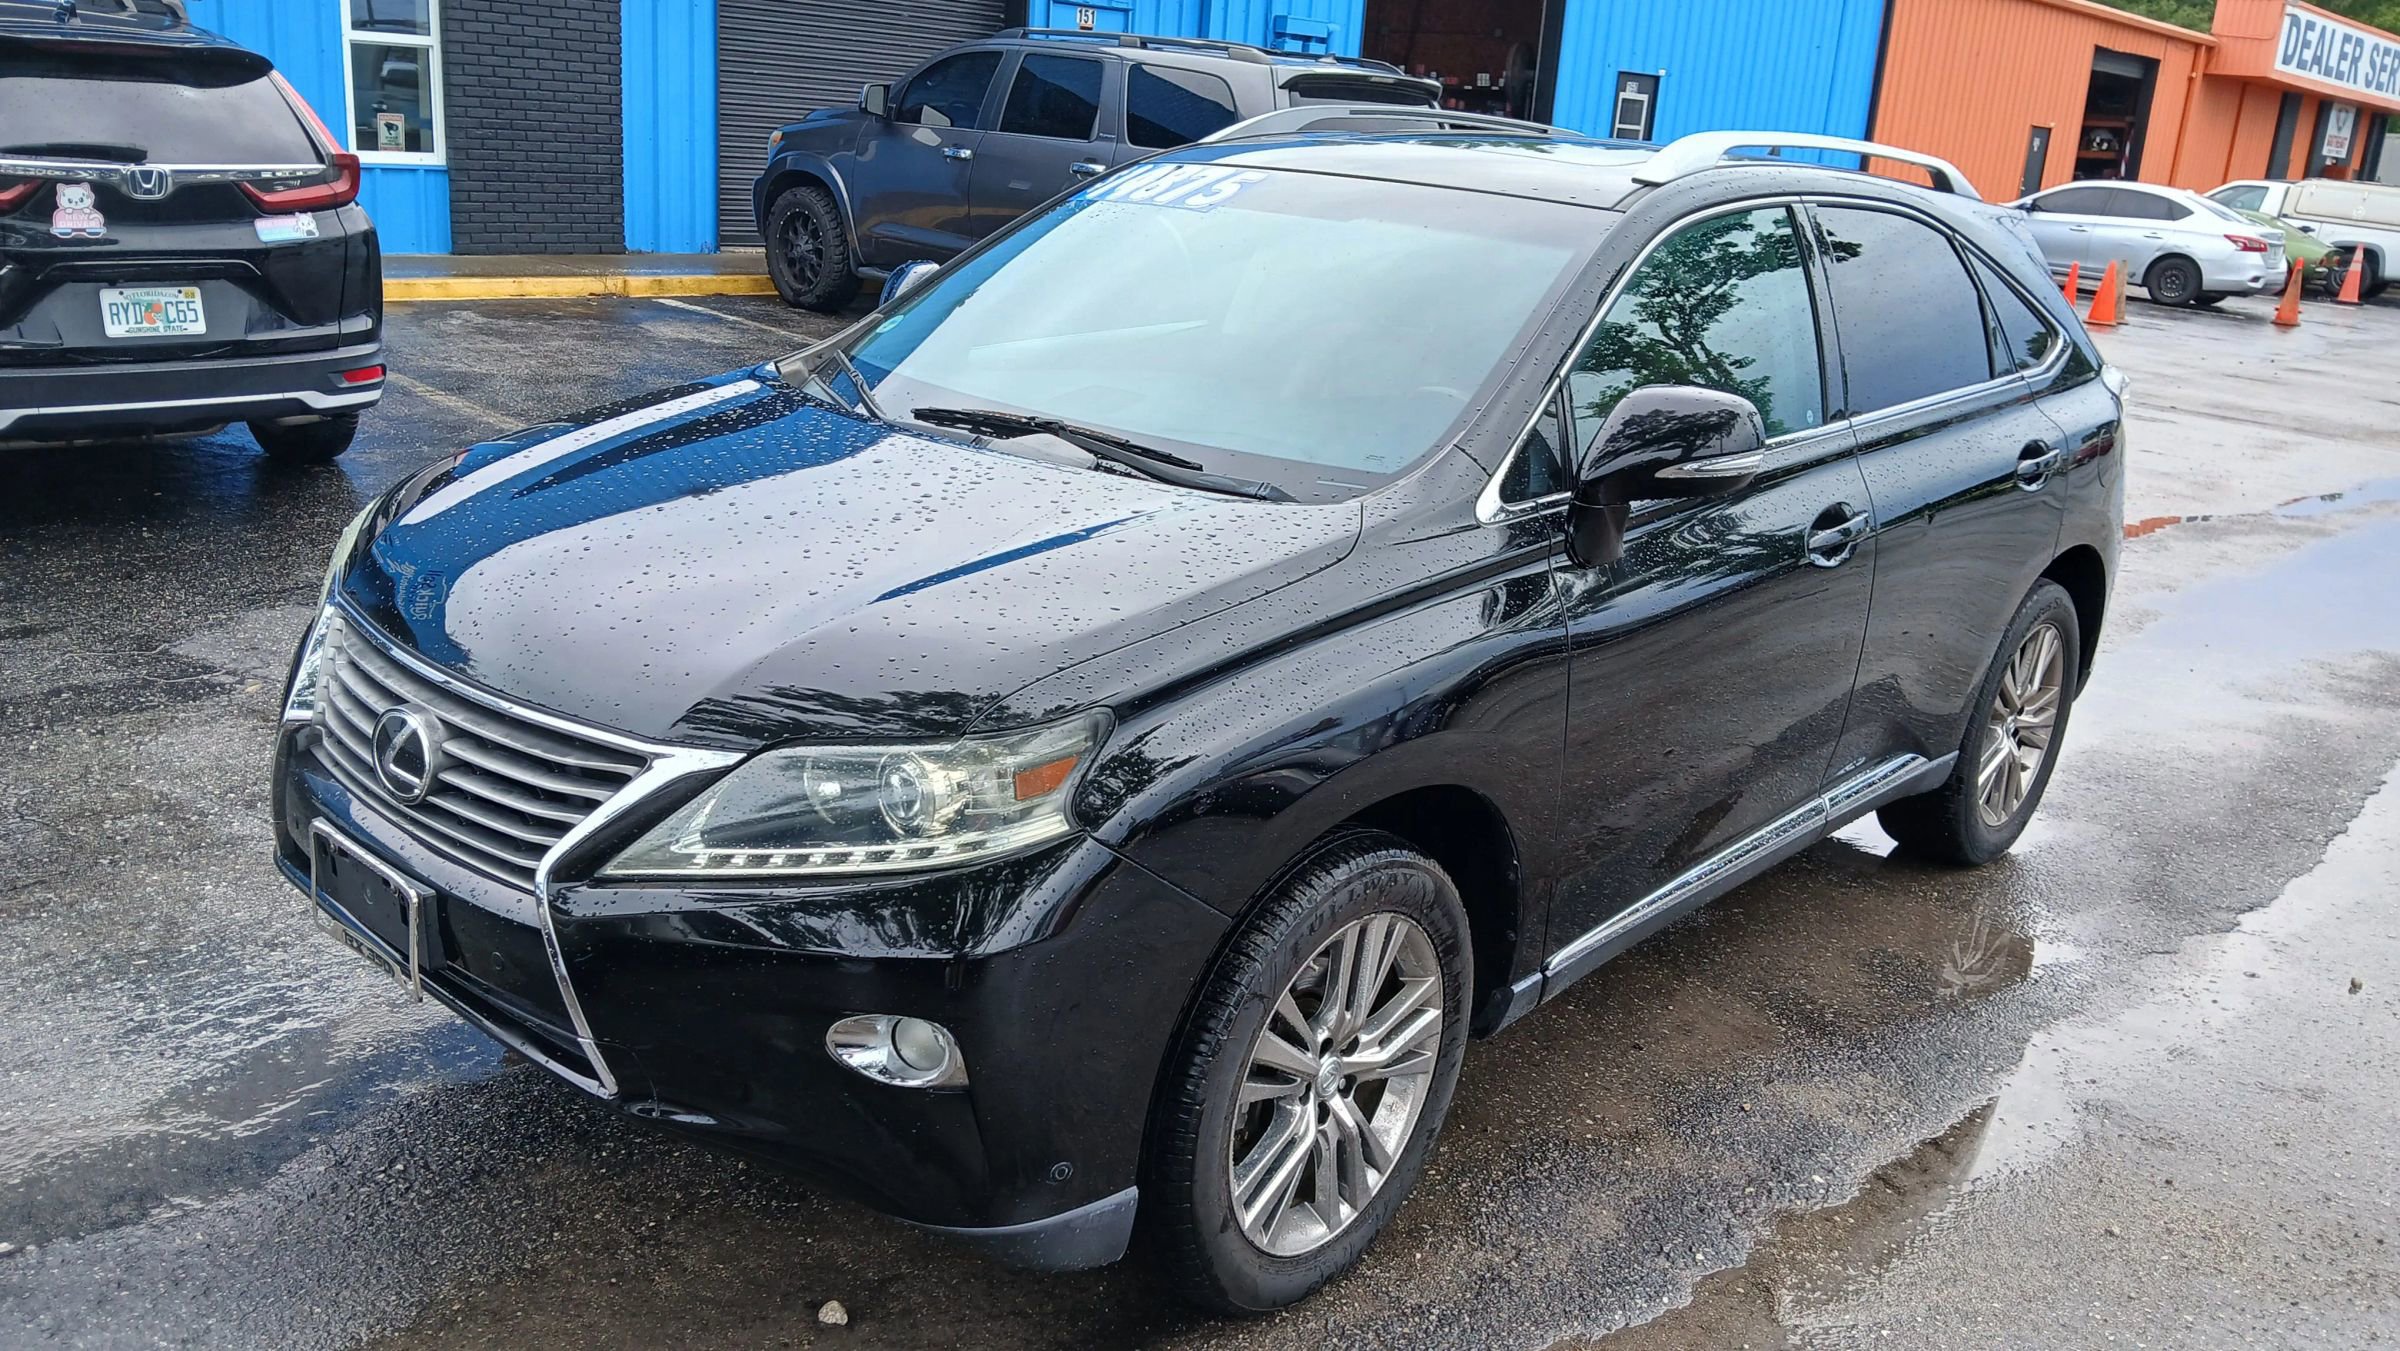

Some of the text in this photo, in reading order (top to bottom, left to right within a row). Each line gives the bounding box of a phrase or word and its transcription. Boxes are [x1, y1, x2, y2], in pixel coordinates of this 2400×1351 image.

[1079, 8, 1095, 24] 151
[2282, 13, 2400, 97] DEALER SER
[109, 301, 198, 325] RYD C65
[128, 326, 161, 334] SUNSHINE
